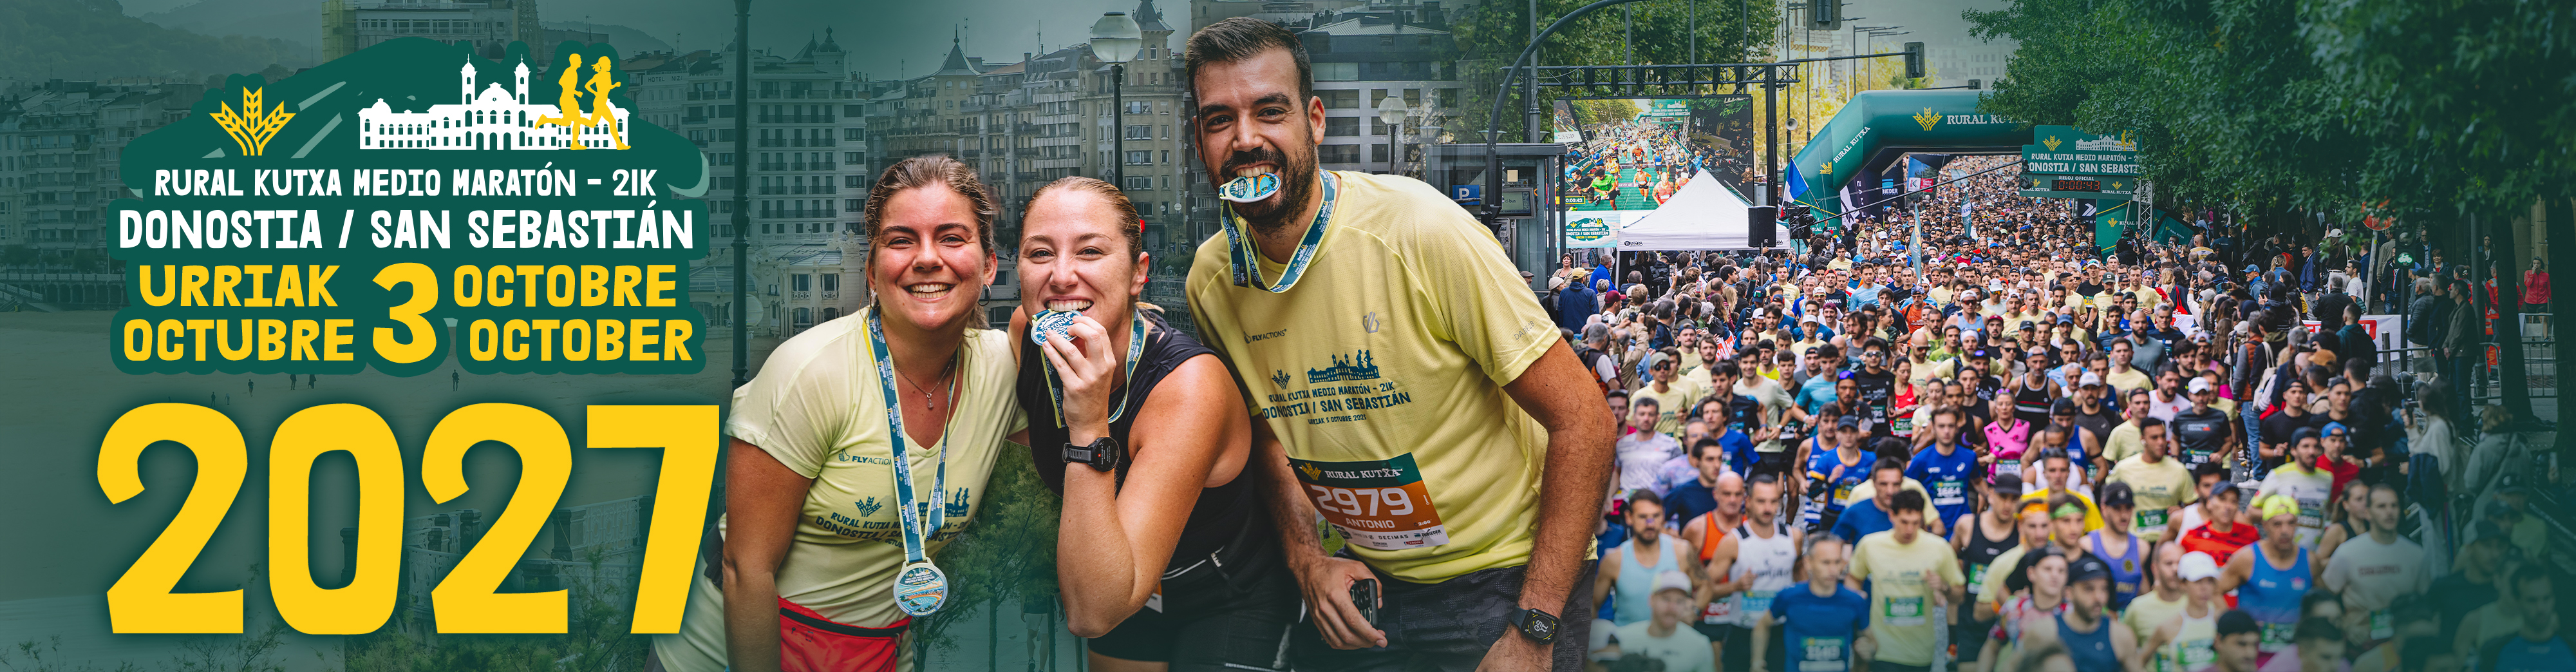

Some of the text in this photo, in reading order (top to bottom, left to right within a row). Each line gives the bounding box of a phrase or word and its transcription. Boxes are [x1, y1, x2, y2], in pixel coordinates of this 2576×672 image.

[1947, 115, 1987, 124] RURAL
[1833, 126, 1870, 164] RURAL KUTXA
[2098, 153, 2127, 162] MARATÓN
[2027, 162, 2069, 172] ONOSTIA
[2072, 163, 2076, 173] /
[2079, 163, 2098, 173] SAN
[2058, 180, 2101, 190] 0:00:43
[1458, 187, 1470, 200] P
[1268, 391, 1287, 403] RURAL
[1288, 389, 1310, 402] KUTXA
[1312, 386, 1336, 399] MEDIO
[1338, 383, 1370, 397] MARATÓN
[1379, 381, 1395, 392] 21K
[1263, 390, 1411, 419] DONOSTIA / SAN SEBASTIÁN
[1308, 416, 1325, 425] URRIAK
[1325, 468, 1401, 479] RURAL KUTXA
[1310, 485, 1414, 517] 2979
[831, 512, 860, 528] RURAL
[863, 521, 890, 530] KUTXA
[1346, 517, 1396, 528] ANTONIO
[816, 516, 881, 539] DONOSTIA
